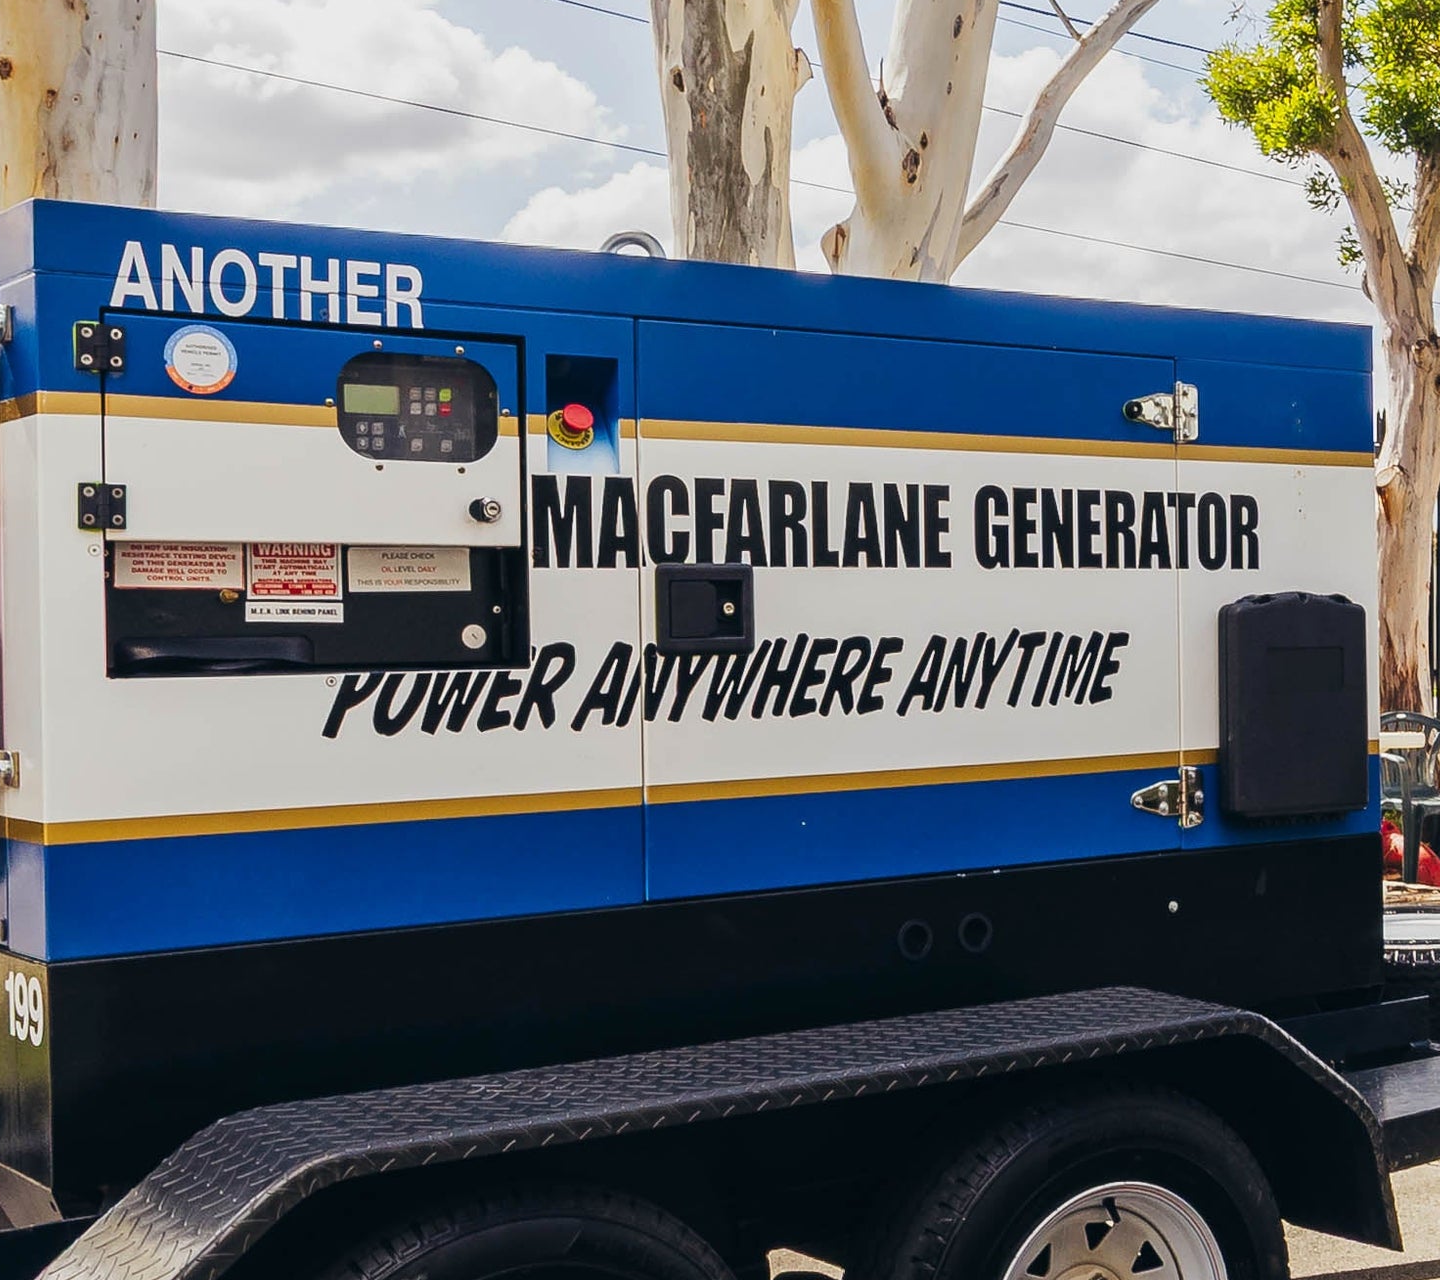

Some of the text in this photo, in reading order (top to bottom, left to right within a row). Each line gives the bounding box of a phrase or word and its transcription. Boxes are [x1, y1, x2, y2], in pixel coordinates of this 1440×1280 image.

[110, 240, 424, 329] ANOTHER
[260, 543, 331, 556] WARNING
[531, 474, 1260, 570] MACFARLANE GENERATOR
[321, 627, 1130, 739] POWER ANYWHERE ANYTIME
[5, 971, 44, 1047] 199
